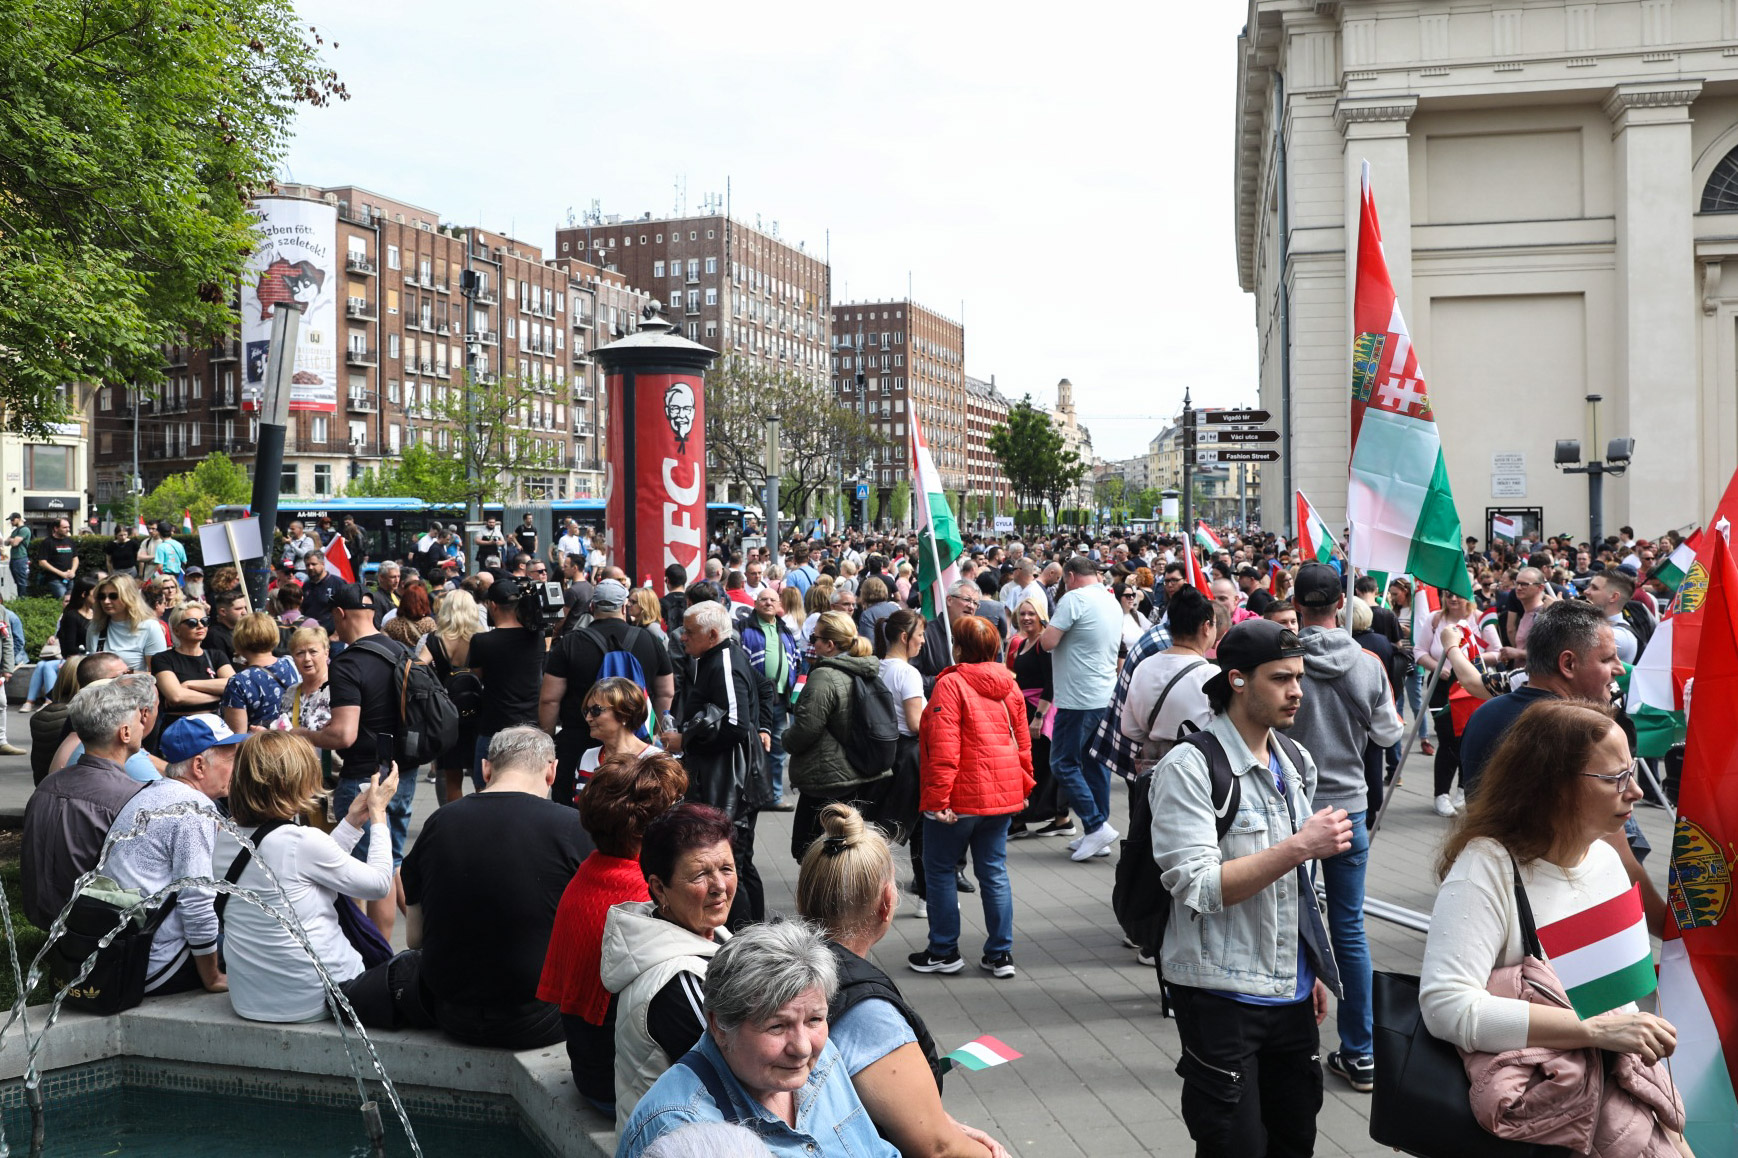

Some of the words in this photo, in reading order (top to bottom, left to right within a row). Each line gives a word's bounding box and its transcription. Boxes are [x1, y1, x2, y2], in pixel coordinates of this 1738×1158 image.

[257, 225, 292, 236] őzben
[278, 236, 326, 258] szeletek!
[662, 457, 702, 596] KFC
